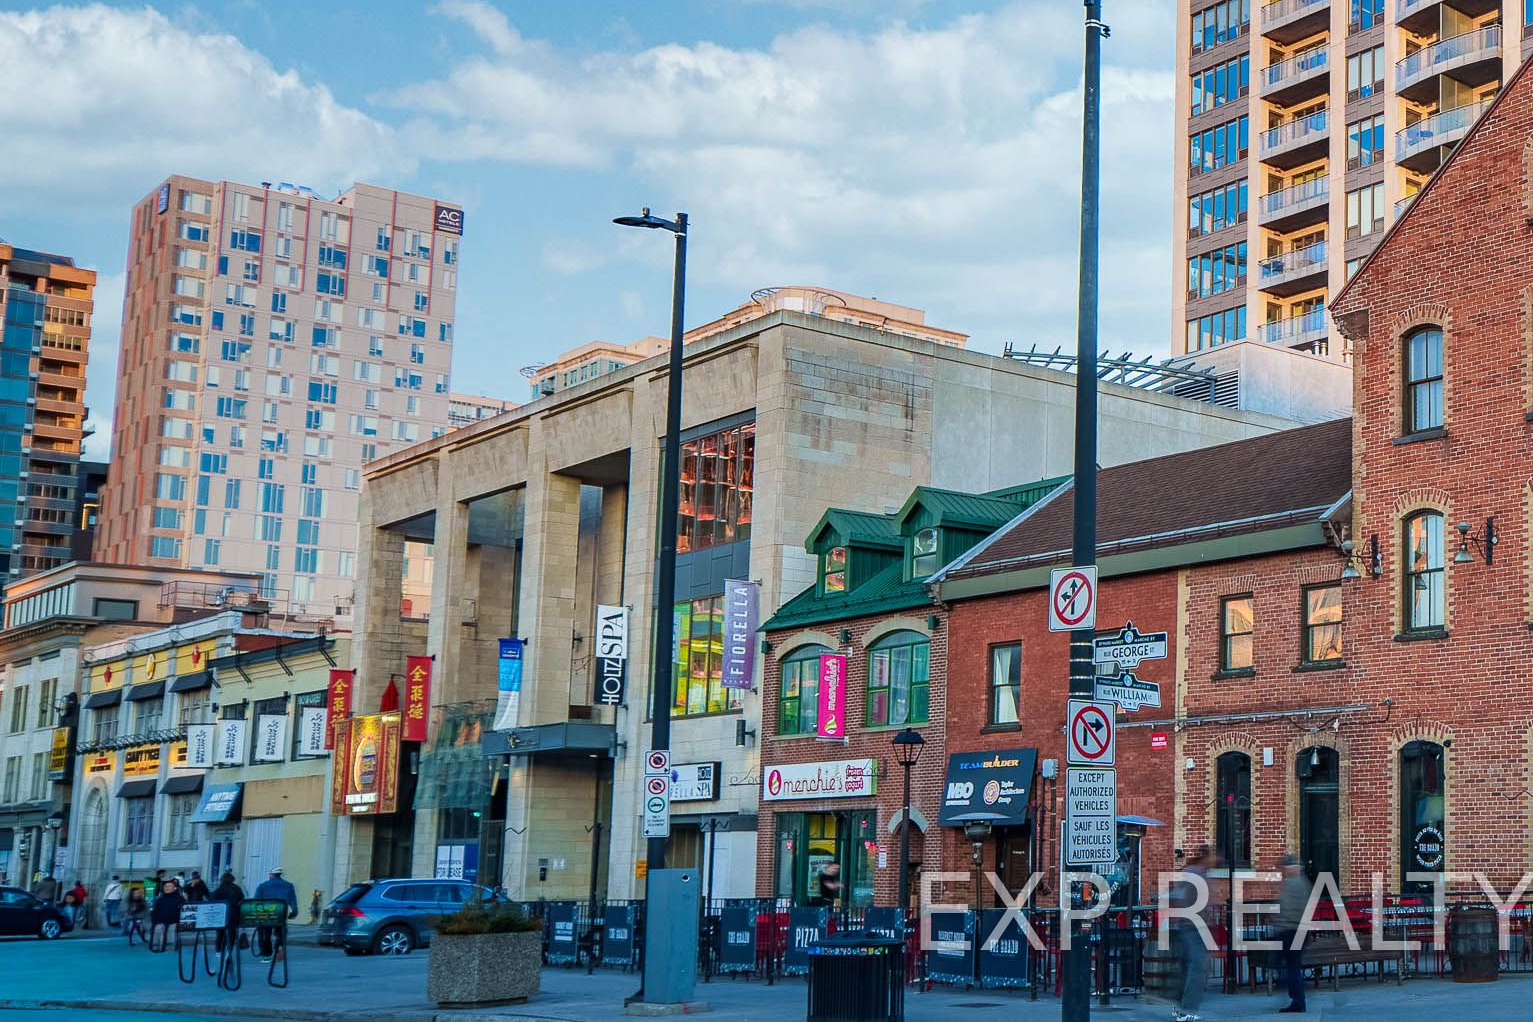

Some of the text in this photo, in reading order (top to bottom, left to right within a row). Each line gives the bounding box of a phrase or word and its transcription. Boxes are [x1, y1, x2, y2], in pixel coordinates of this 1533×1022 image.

[439, 209, 460, 222] AC
[601, 612, 623, 657] SPA
[730, 587, 748, 675] FIORELLA
[1112, 645, 1149, 658] GEORGE
[408, 665, 427, 719] 全聚德
[1112, 688, 1148, 702] WILLIAM
[783, 766, 843, 795] menchie's
[1078, 772, 1105, 783] EXCEPT
[845, 778, 863, 792] yogurt
[946, 781, 974, 799] MBO
[1070, 786, 1114, 797] AUTHORIZED
[1074, 800, 1109, 811] VEHICLES
[1074, 820, 1110, 832] SAUF LES
[1072, 832, 1112, 846] VÉHICULES
[1072, 846, 1110, 859] AUTORISÉS
[795, 928, 819, 948] PIZZA
